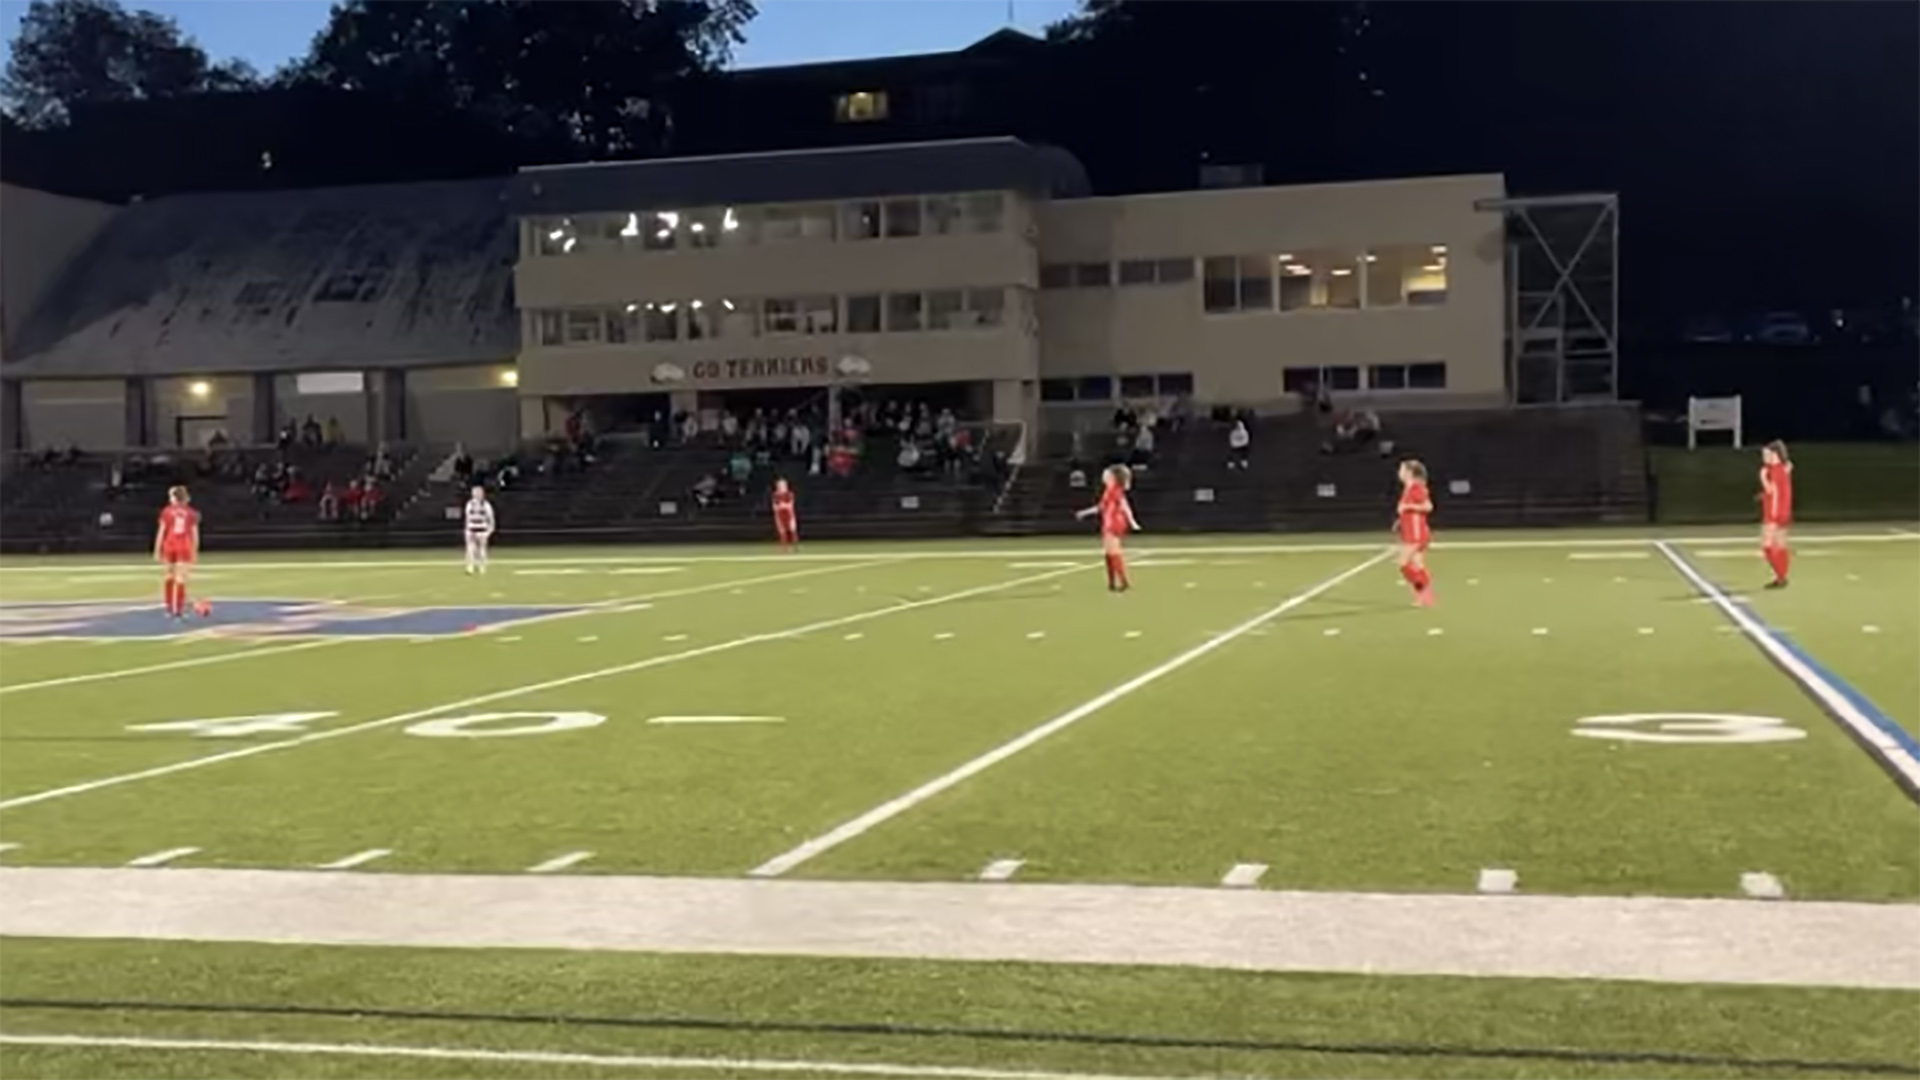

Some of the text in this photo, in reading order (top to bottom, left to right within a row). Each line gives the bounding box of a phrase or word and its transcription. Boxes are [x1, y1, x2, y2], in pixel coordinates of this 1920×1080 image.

[692, 356, 828, 379] GO TERRIERS
[1570, 712, 1808, 743] 3
